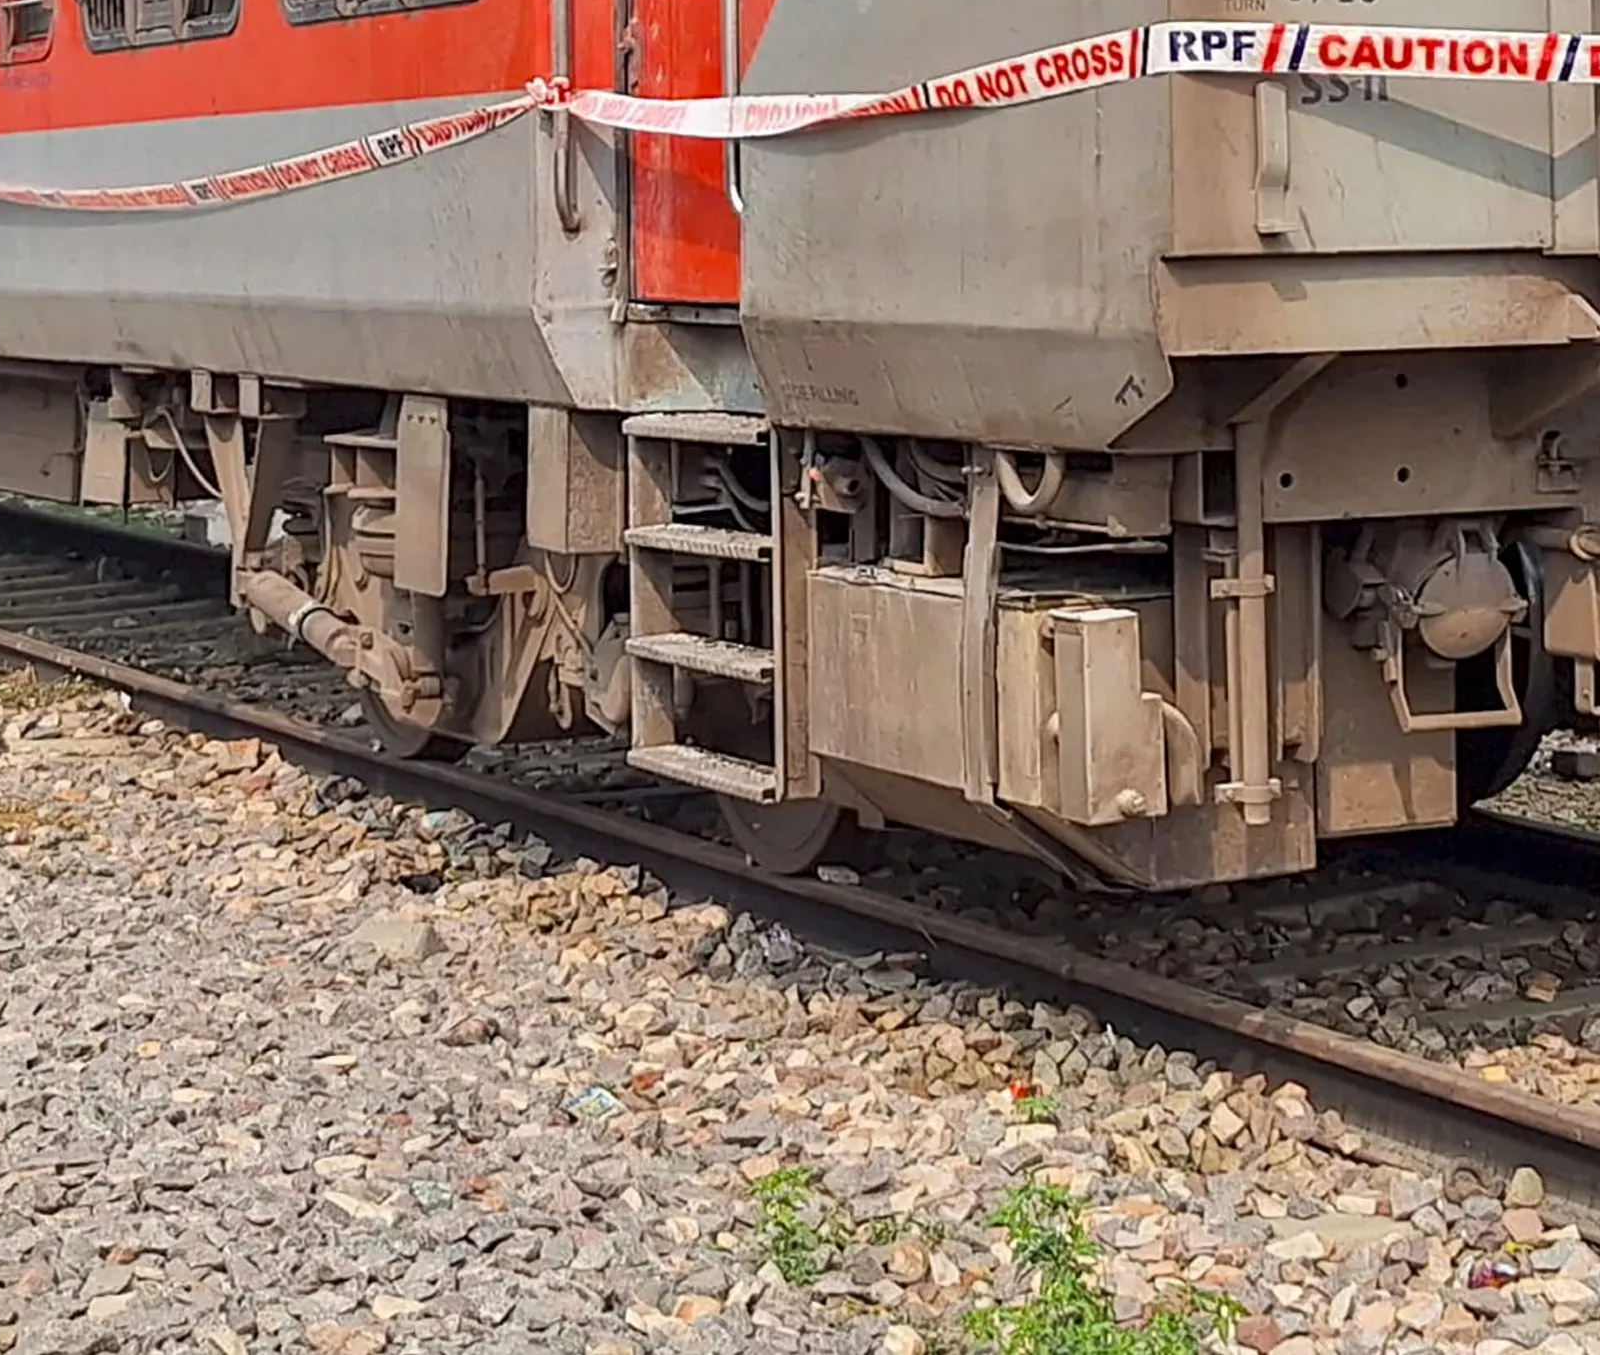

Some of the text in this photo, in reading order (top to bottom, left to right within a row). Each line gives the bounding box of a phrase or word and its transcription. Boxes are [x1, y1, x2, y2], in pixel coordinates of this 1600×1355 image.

[977, 64, 1030, 103] NOT
[1040, 40, 1125, 90] CROSS
[1169, 30, 1258, 63] RPF
[1319, 34, 1528, 75] CAUTION
[221, 171, 274, 196] CAUTION
[278, 165, 298, 186] DO
[299, 158, 326, 181] NOT
[328, 146, 368, 174] CROSS
[377, 134, 404, 160] RPF
[419, 111, 489, 147] CAUTION
